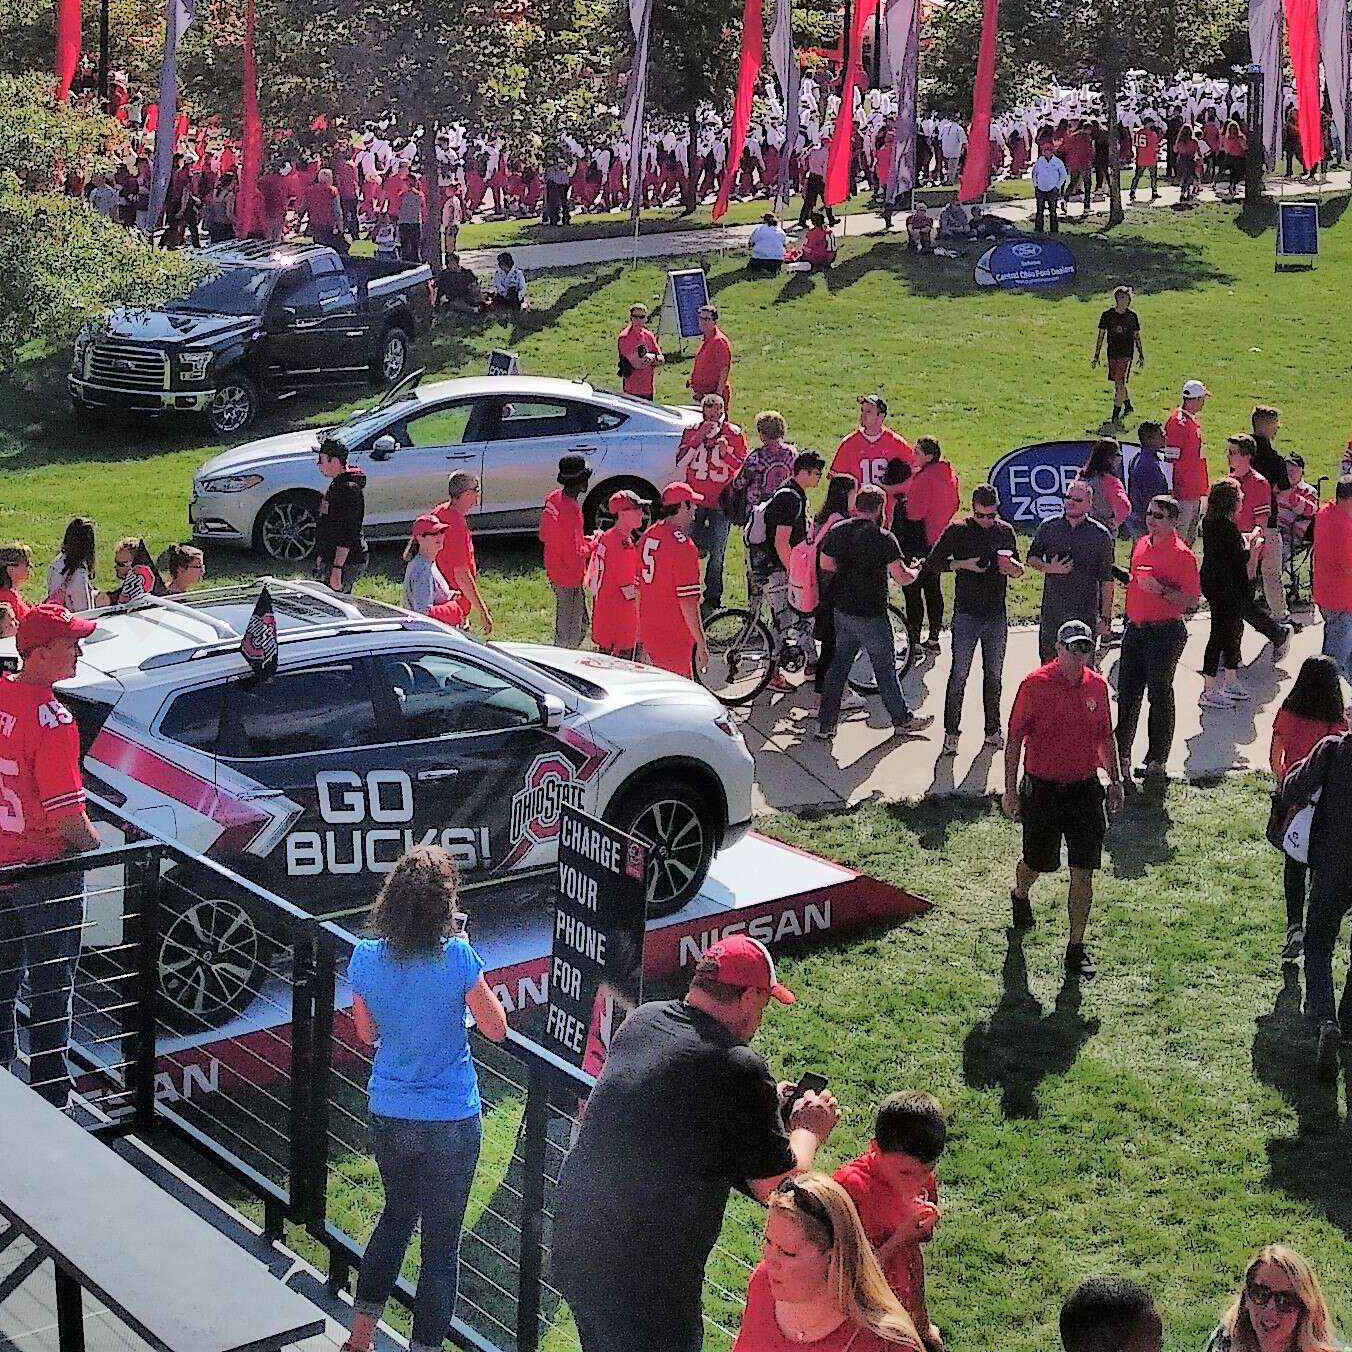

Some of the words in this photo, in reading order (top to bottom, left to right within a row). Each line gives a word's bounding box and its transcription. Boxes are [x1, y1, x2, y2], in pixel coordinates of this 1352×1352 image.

[316, 769, 414, 824] GO
[562, 815, 621, 874] CHARGE
[559, 861, 598, 912] YOUR
[556, 909, 606, 966] PHONE
[552, 956, 582, 1001] FOR
[547, 1002, 586, 1054] FREE
